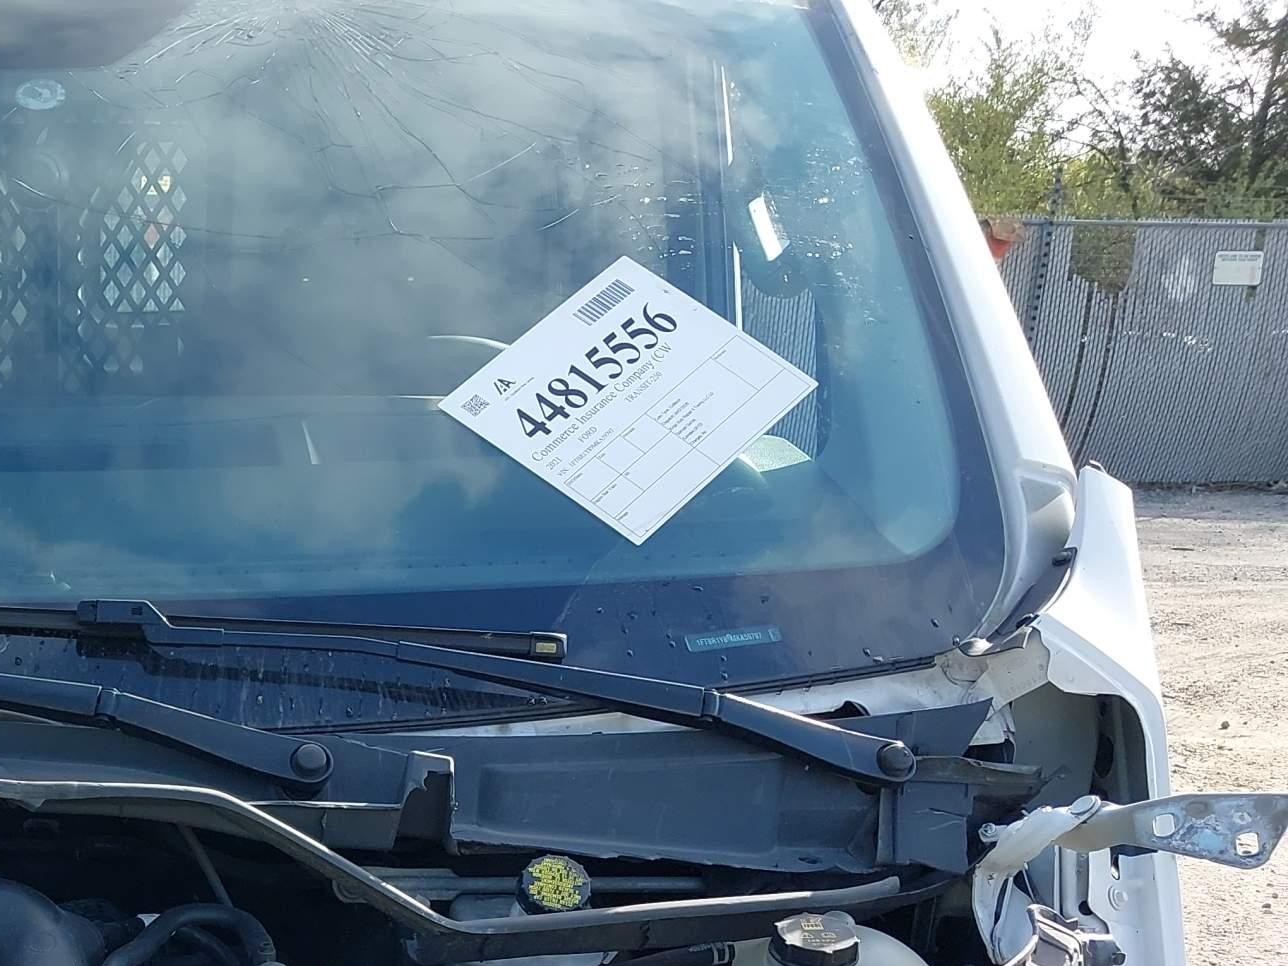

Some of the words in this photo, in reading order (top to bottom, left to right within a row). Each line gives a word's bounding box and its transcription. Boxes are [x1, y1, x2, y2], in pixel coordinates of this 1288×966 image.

[516, 302, 678, 438] 44815556
[531, 423, 579, 462] Commerce
[576, 390, 617, 425] Insurance
[614, 359, 656, 393] Company
[651, 342, 673, 362] (CW
[577, 426, 598, 443] FORD
